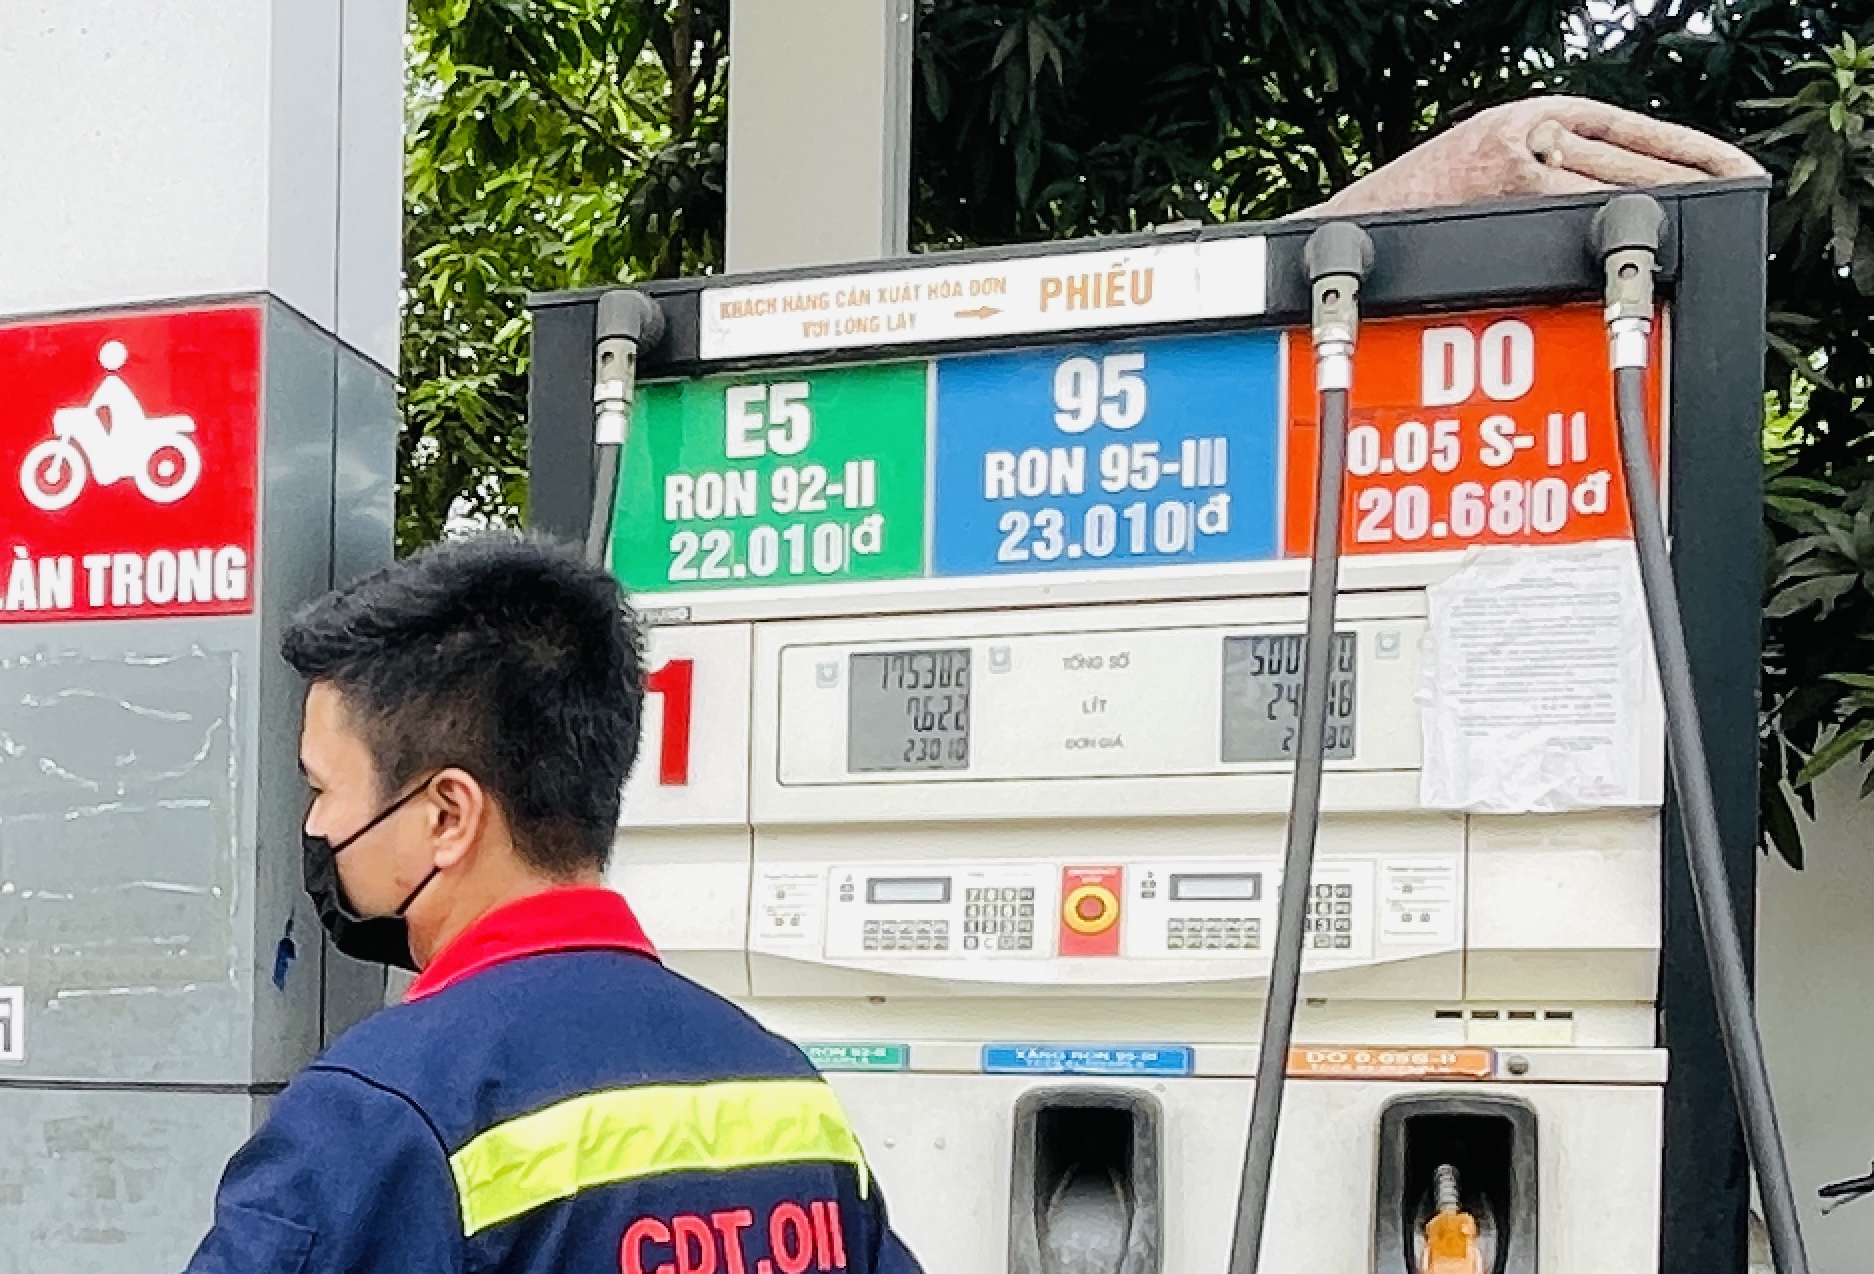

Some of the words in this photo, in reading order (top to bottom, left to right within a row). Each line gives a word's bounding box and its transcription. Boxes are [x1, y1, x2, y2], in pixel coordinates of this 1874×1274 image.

[1039, 257, 1154, 313] PHIẾU
[1053, 352, 1148, 433] 95
[1421, 319, 1535, 407] DO
[726, 381, 811, 459] E5
[1347, 419, 1461, 476] 0.05
[664, 469, 758, 521] RON
[771, 459, 876, 514] 92-II
[984, 446, 1086, 500] RON
[1100, 436, 1229, 493] 95-III
[83, 544, 248, 607] TRONG
[646, 658, 694, 786] 1
